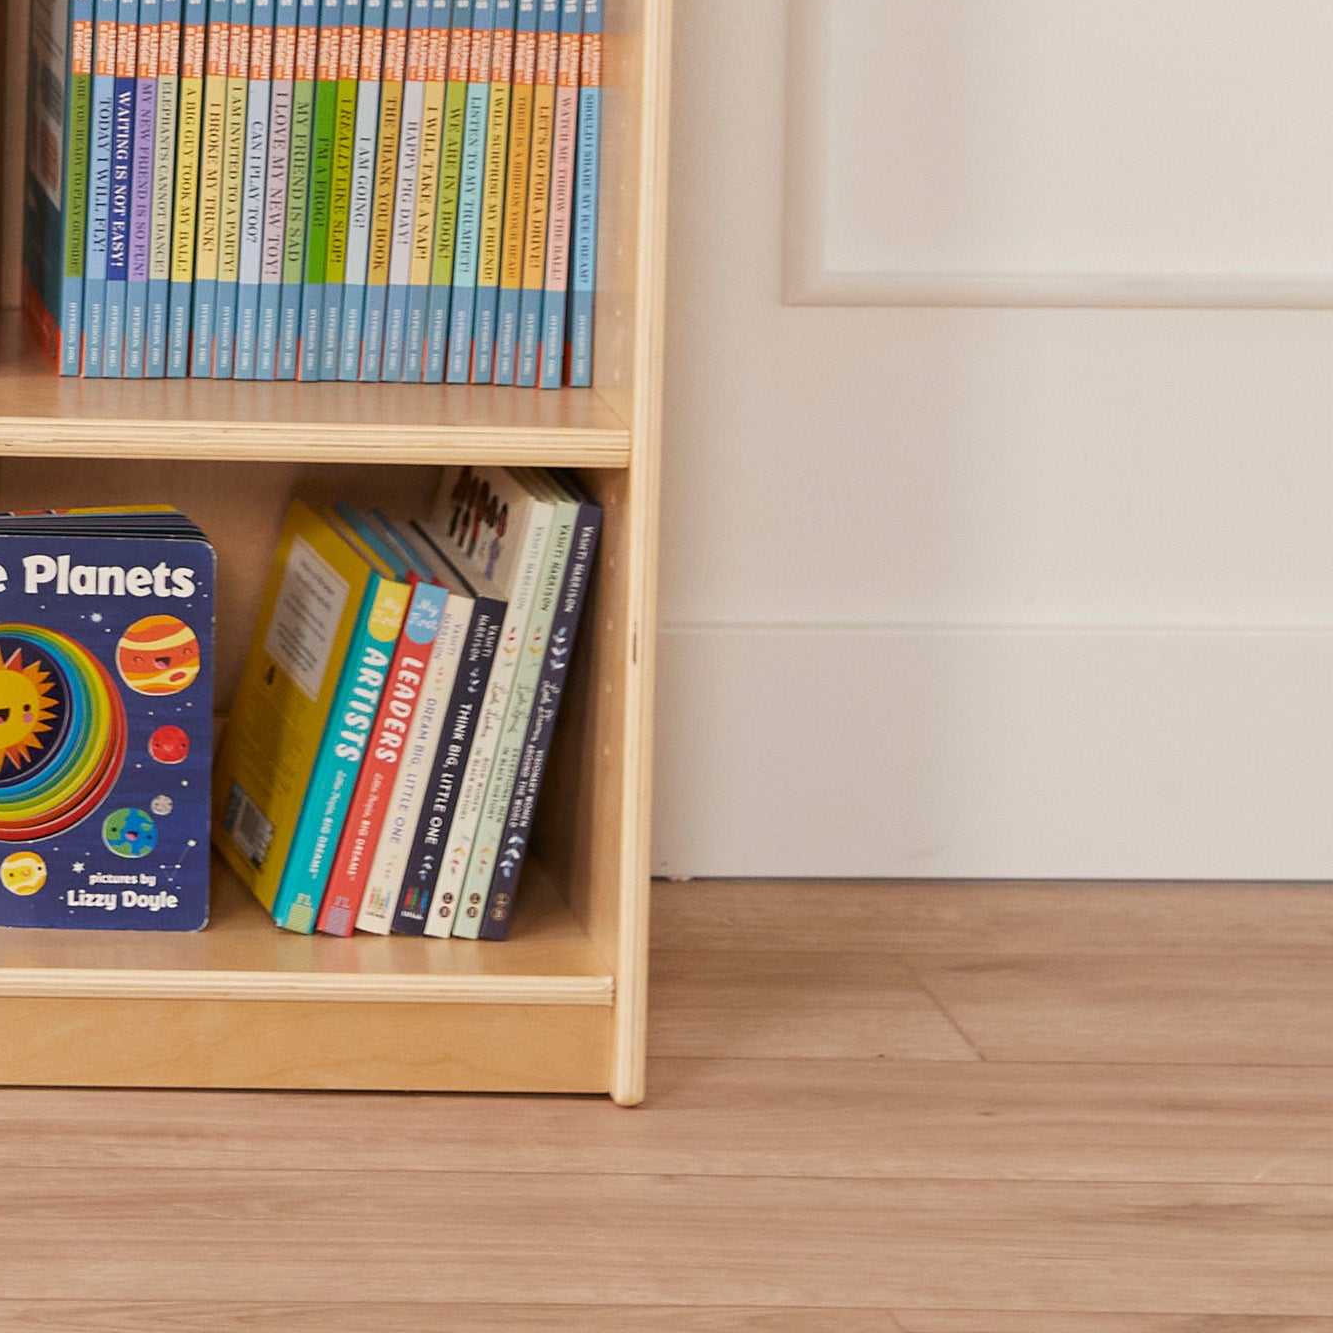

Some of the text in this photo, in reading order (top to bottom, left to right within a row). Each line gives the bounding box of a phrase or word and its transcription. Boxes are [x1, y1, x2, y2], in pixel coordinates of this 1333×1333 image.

[97, 97, 112, 151] TODAY
[273, 104, 288, 148] LOVE
[110, 90, 131, 267] WAITING IS NOT EASY!
[271, 157, 286, 179] MY
[95, 169, 108, 213] WILL
[267, 188, 282, 228] NEW
[22, 554, 195, 598] Planets
[334, 646, 389, 762] ARTISTS
[374, 656, 425, 764] LEADERS
[424, 614, 500, 845] VASHTI HARRISON THINK BIG, LITTLE ONE
[66, 889, 178, 912] Lizzy Doyle
[88, 871, 157, 888] pictures by
